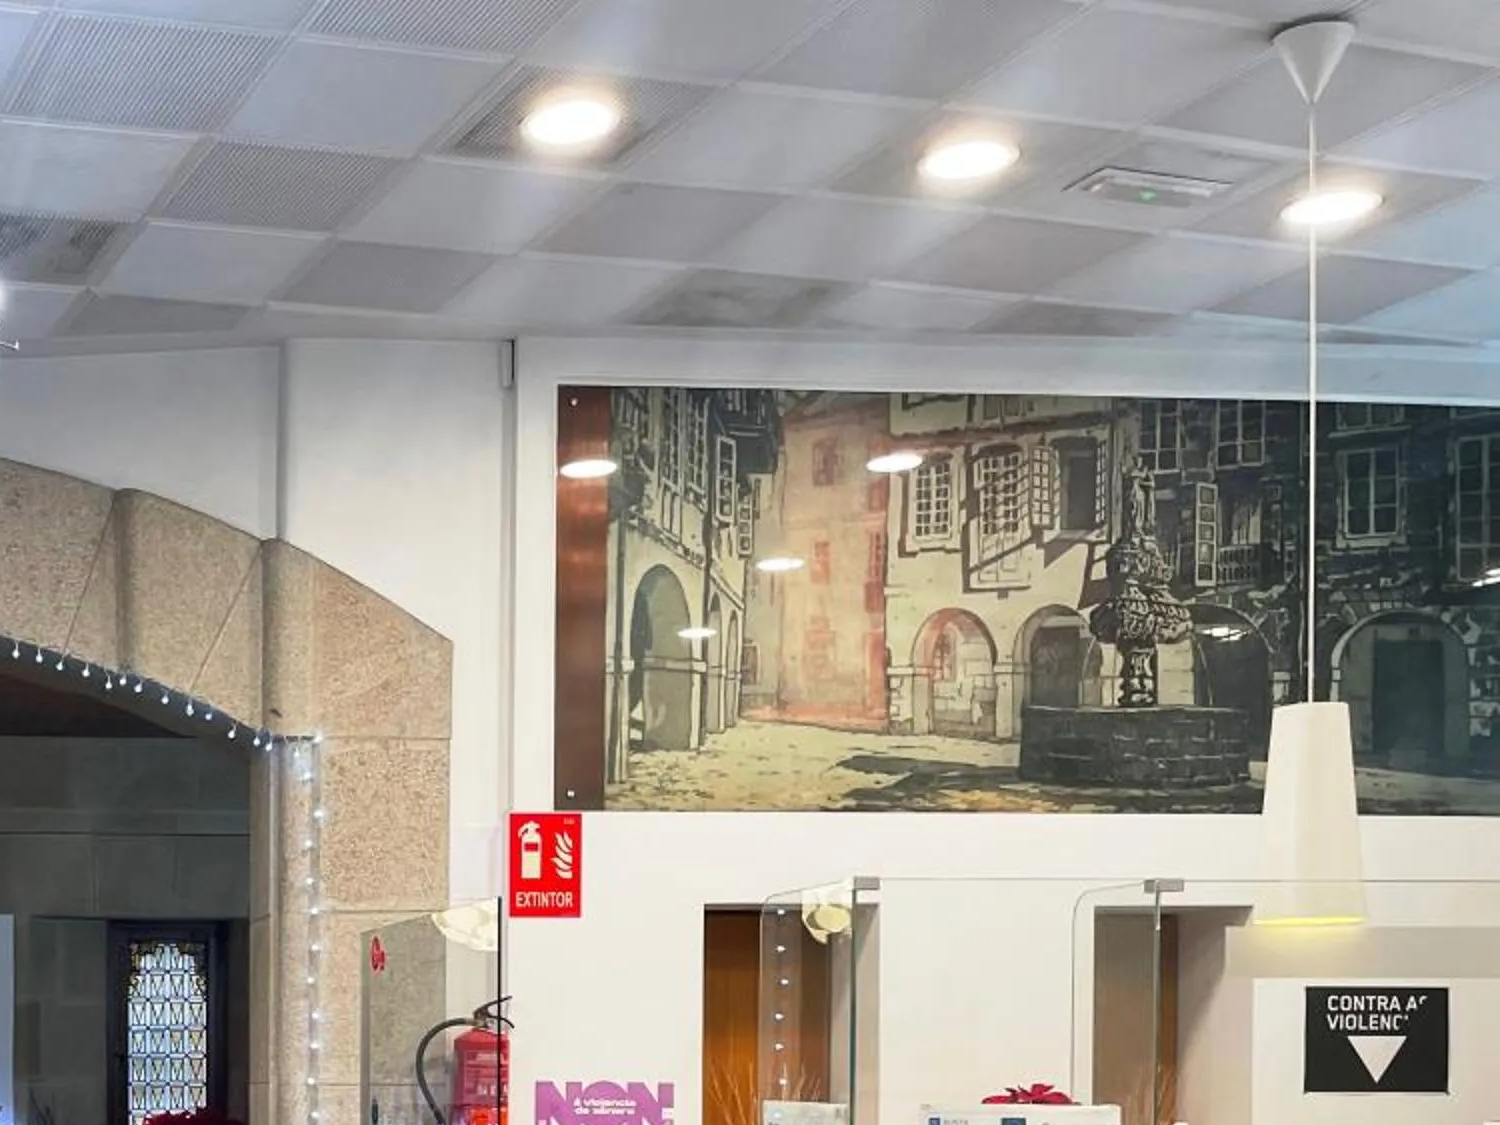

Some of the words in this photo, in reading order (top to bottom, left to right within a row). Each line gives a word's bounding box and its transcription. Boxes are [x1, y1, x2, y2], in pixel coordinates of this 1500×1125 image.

[515, 891, 574, 908] EXTINTOR
[1326, 995, 1402, 1012] CONTRA
[1326, 1013, 1409, 1031] VIOLENC
